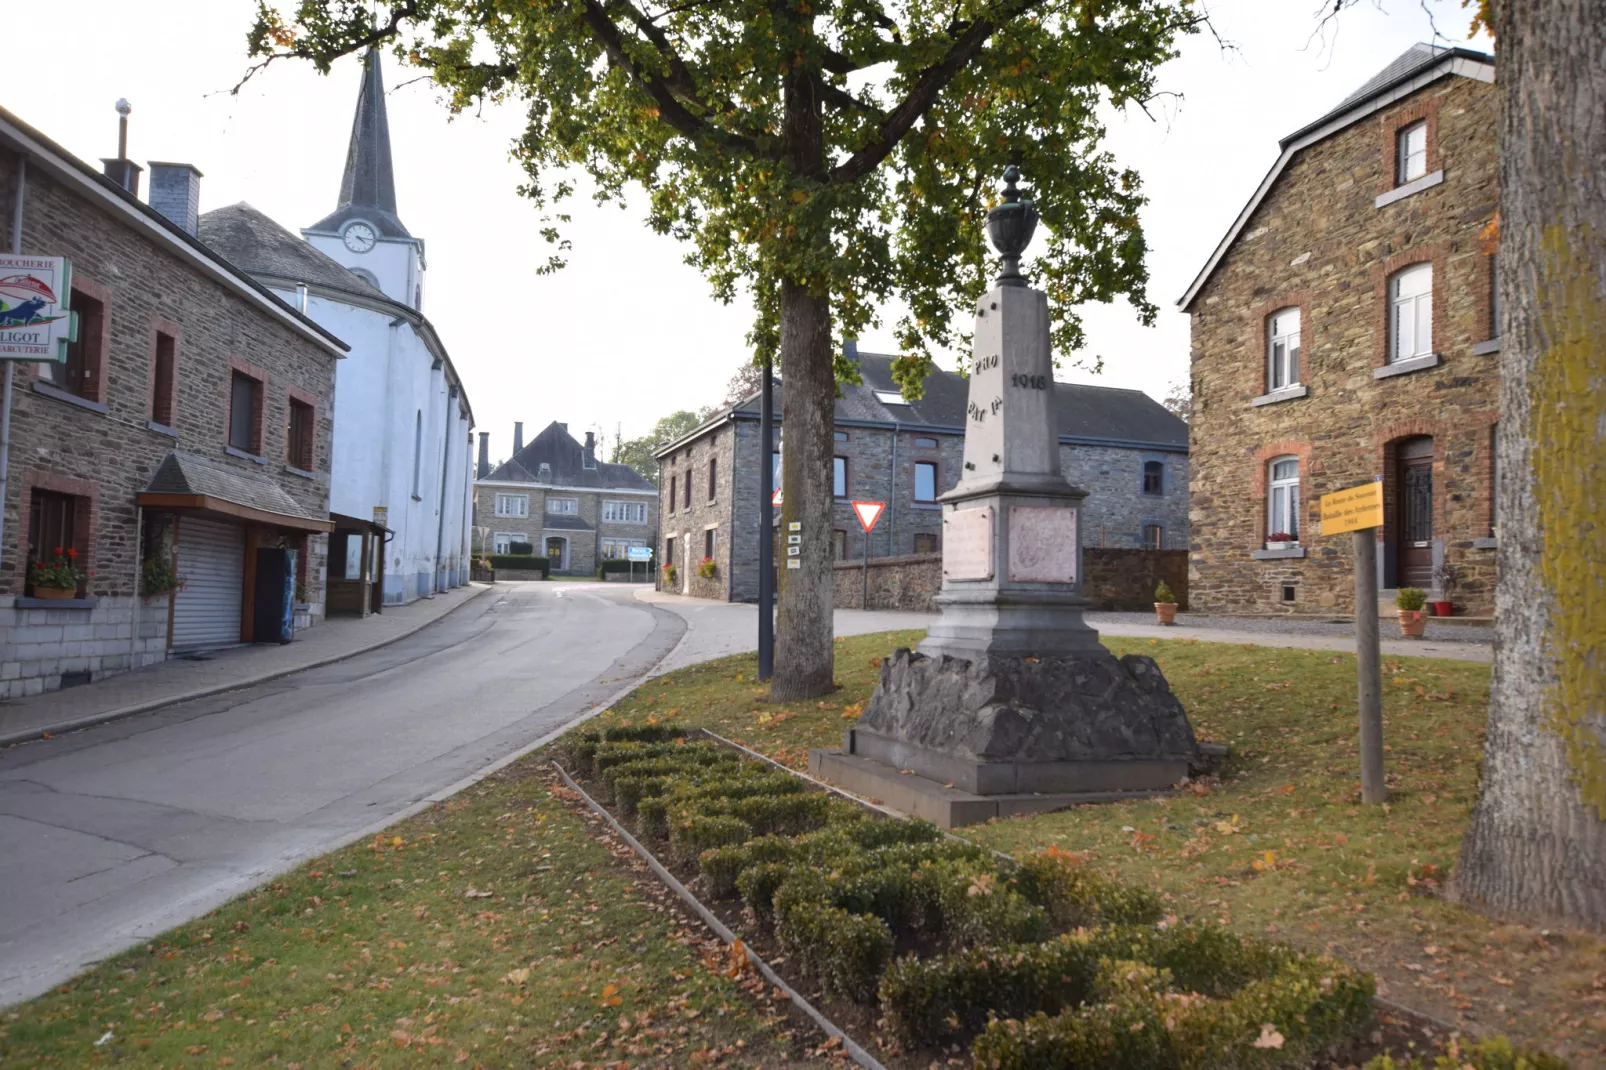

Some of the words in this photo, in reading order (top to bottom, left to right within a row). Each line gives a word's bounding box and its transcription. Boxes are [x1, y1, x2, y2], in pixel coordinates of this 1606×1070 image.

[0, 331, 40, 343] LIGOT
[0, 345, 49, 354] ARCUTERIE
[975, 354, 998, 375] PRO
